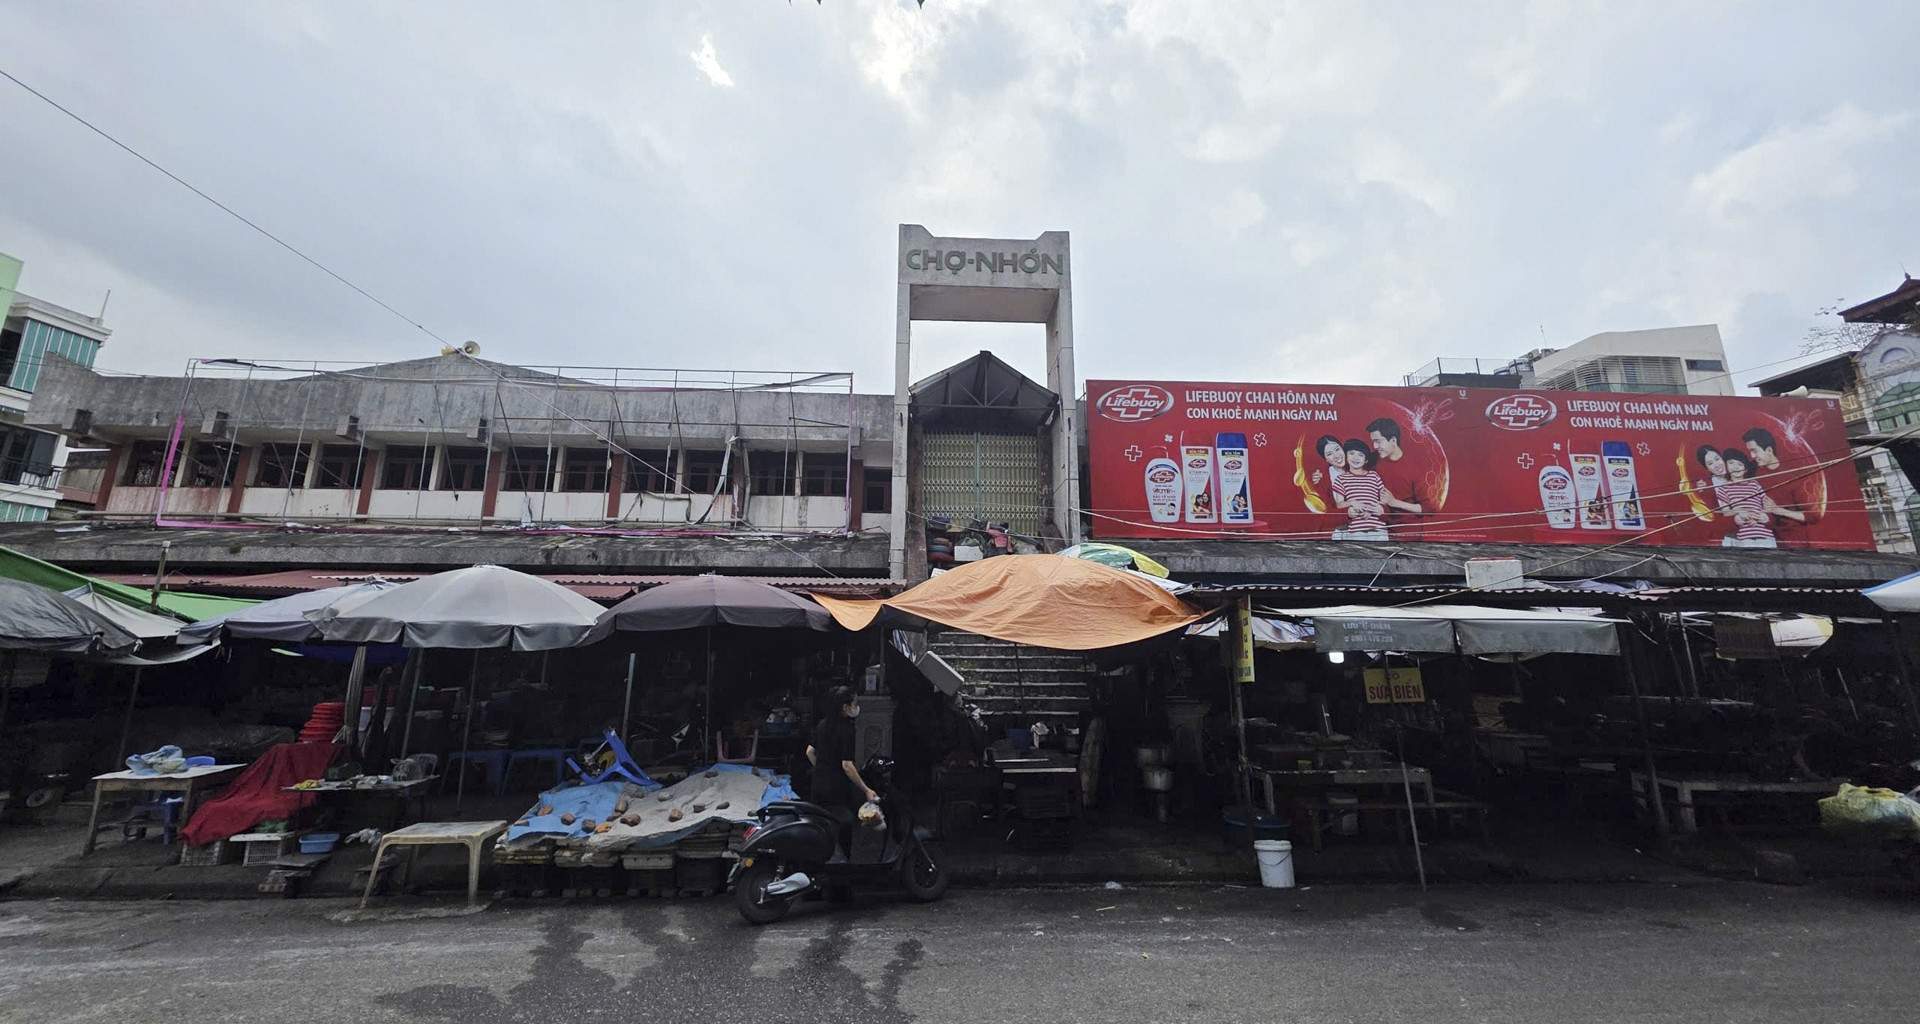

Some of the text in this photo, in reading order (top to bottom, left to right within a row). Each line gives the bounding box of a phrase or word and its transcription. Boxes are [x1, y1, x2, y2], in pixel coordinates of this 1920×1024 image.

[1105, 396, 1164, 409] Lifebuoy
[1185, 390, 1336, 406] LIFEBUOY CHAI HÔM NAY
[1186, 407, 1210, 419] CON
[1244, 409, 1280, 422] MẠNH
[1282, 407, 1313, 421] NGÀY
[1315, 409, 1338, 421] MAI
[1494, 405, 1549, 418] Lifebuoy
[1567, 400, 1709, 416] LIFEBUOY CHAI HÔM NAY
[1570, 416, 1593, 428] CON
[1625, 418, 1659, 432] MẠNH
[1660, 418, 1689, 431] NGÀY
[1691, 420, 1714, 432] MAI
